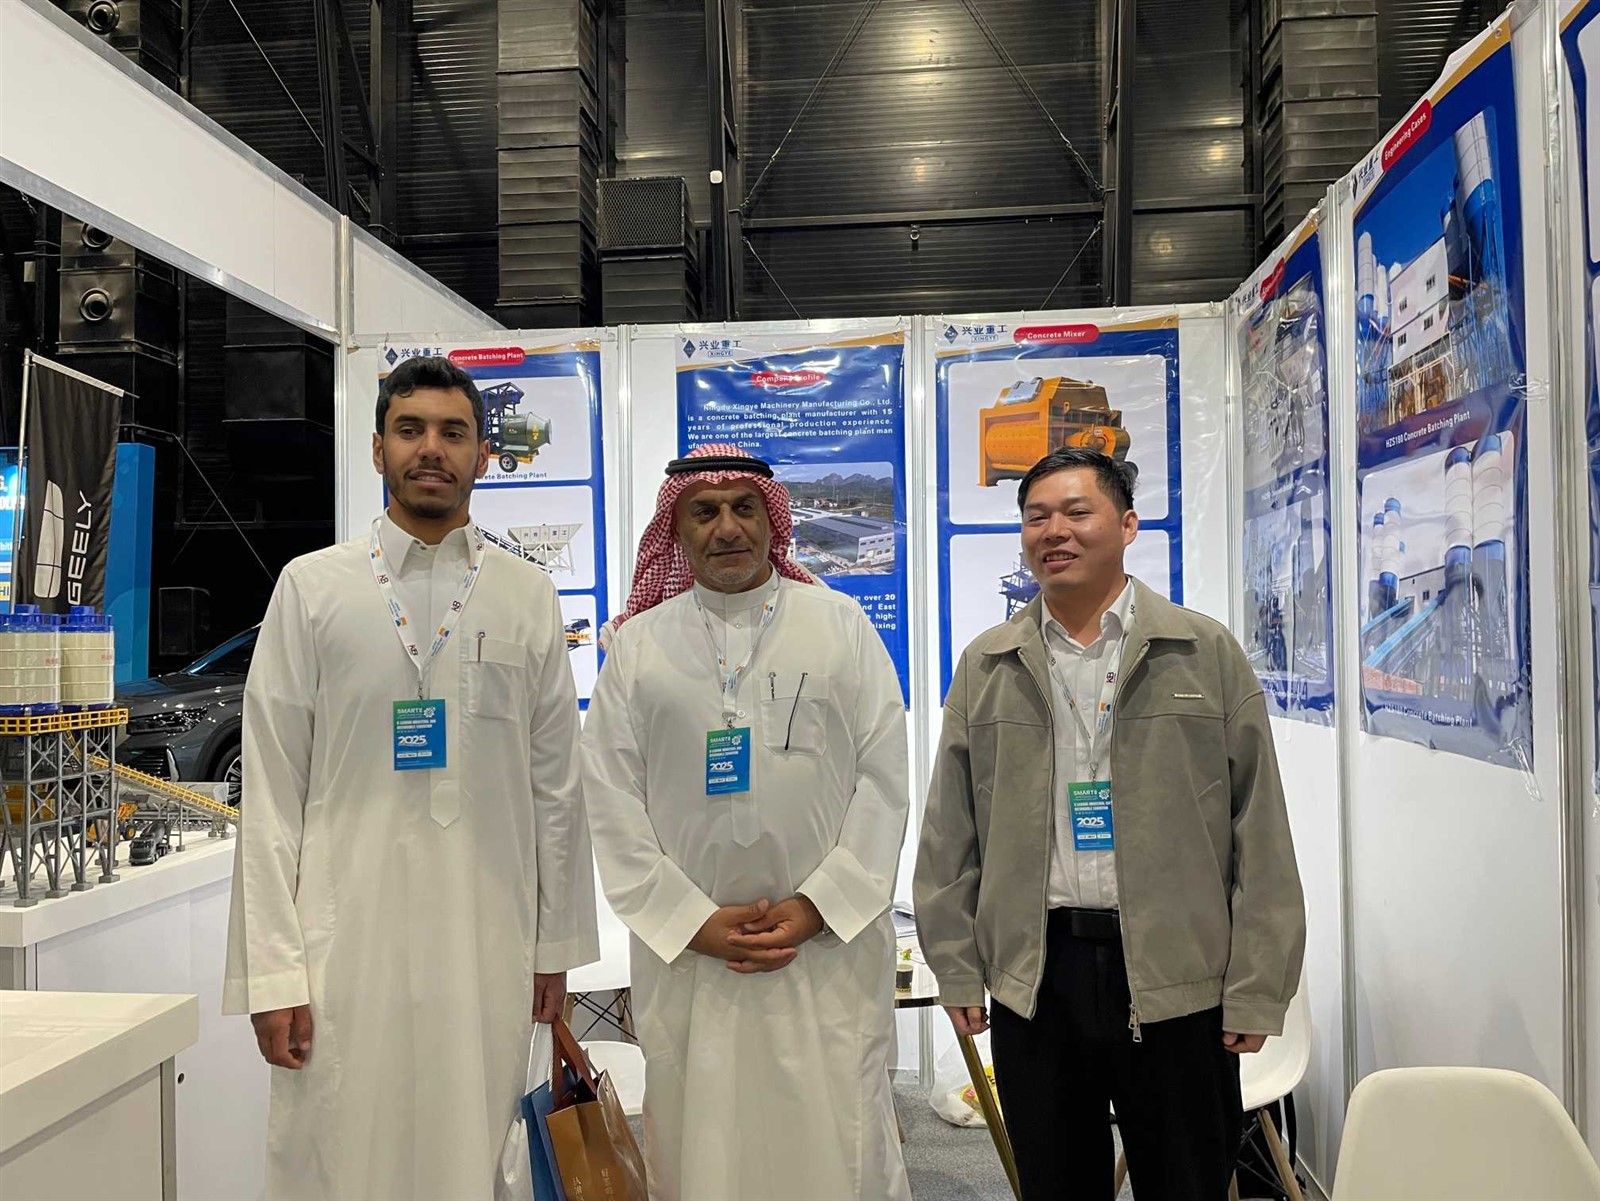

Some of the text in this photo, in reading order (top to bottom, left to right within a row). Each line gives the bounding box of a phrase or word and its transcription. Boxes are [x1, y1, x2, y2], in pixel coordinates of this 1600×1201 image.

[1384, 112, 1427, 160] Engineering Cases
[962, 325, 1007, 335] 兴业重工
[1027, 331, 1062, 339] Concrete
[699, 340, 741, 350] 兴业重工
[400, 347, 442, 358] 兴业重工
[801, 400, 857, 408] Manufacturing
[706, 413, 740, 421] concrete
[743, 412, 778, 420] batching
[687, 424, 711, 432] years
[789, 420, 837, 428] production
[842, 418, 893, 426] experience.
[1404, 427, 1427, 442] Concrete
[1427, 417, 1454, 433] Batching
[1453, 411, 1471, 424] Plant
[818, 429, 852, 437] batching
[854, 427, 875, 435] plant
[497, 472, 528, 480] Batching
[67, 490, 92, 606] GEELY
[875, 613, 896, 621] high-
[398, 735, 427, 745] 2025
[709, 761, 733, 771] 2025
[1076, 816, 1105, 827] 2025
